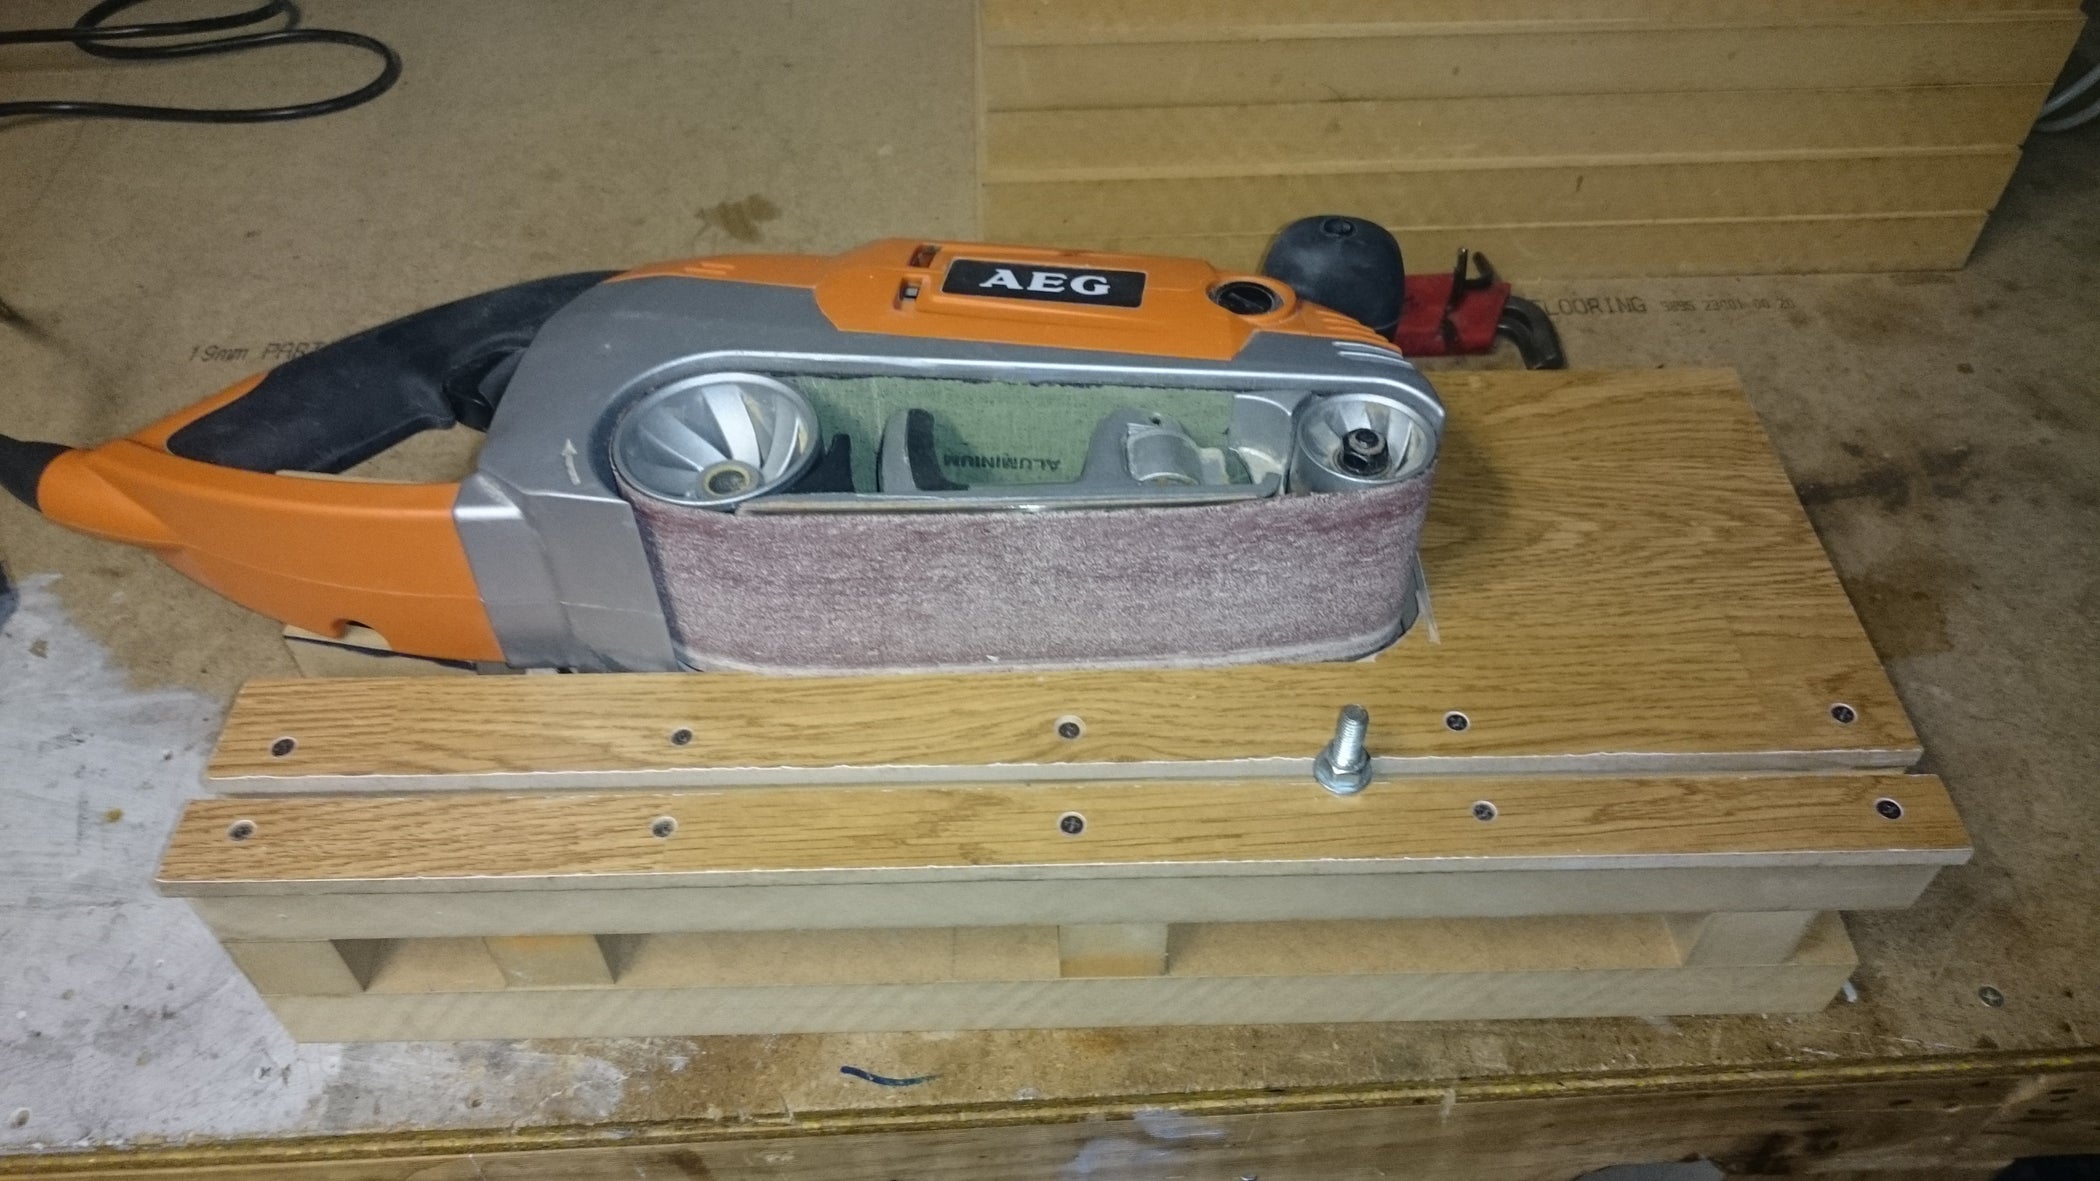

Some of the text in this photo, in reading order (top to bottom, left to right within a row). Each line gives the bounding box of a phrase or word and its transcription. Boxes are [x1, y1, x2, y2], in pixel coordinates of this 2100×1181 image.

[979, 268, 1111, 296] AEG
[1536, 296, 1648, 316] LOORING
[943, 454, 1061, 472] ALUMINIUM
